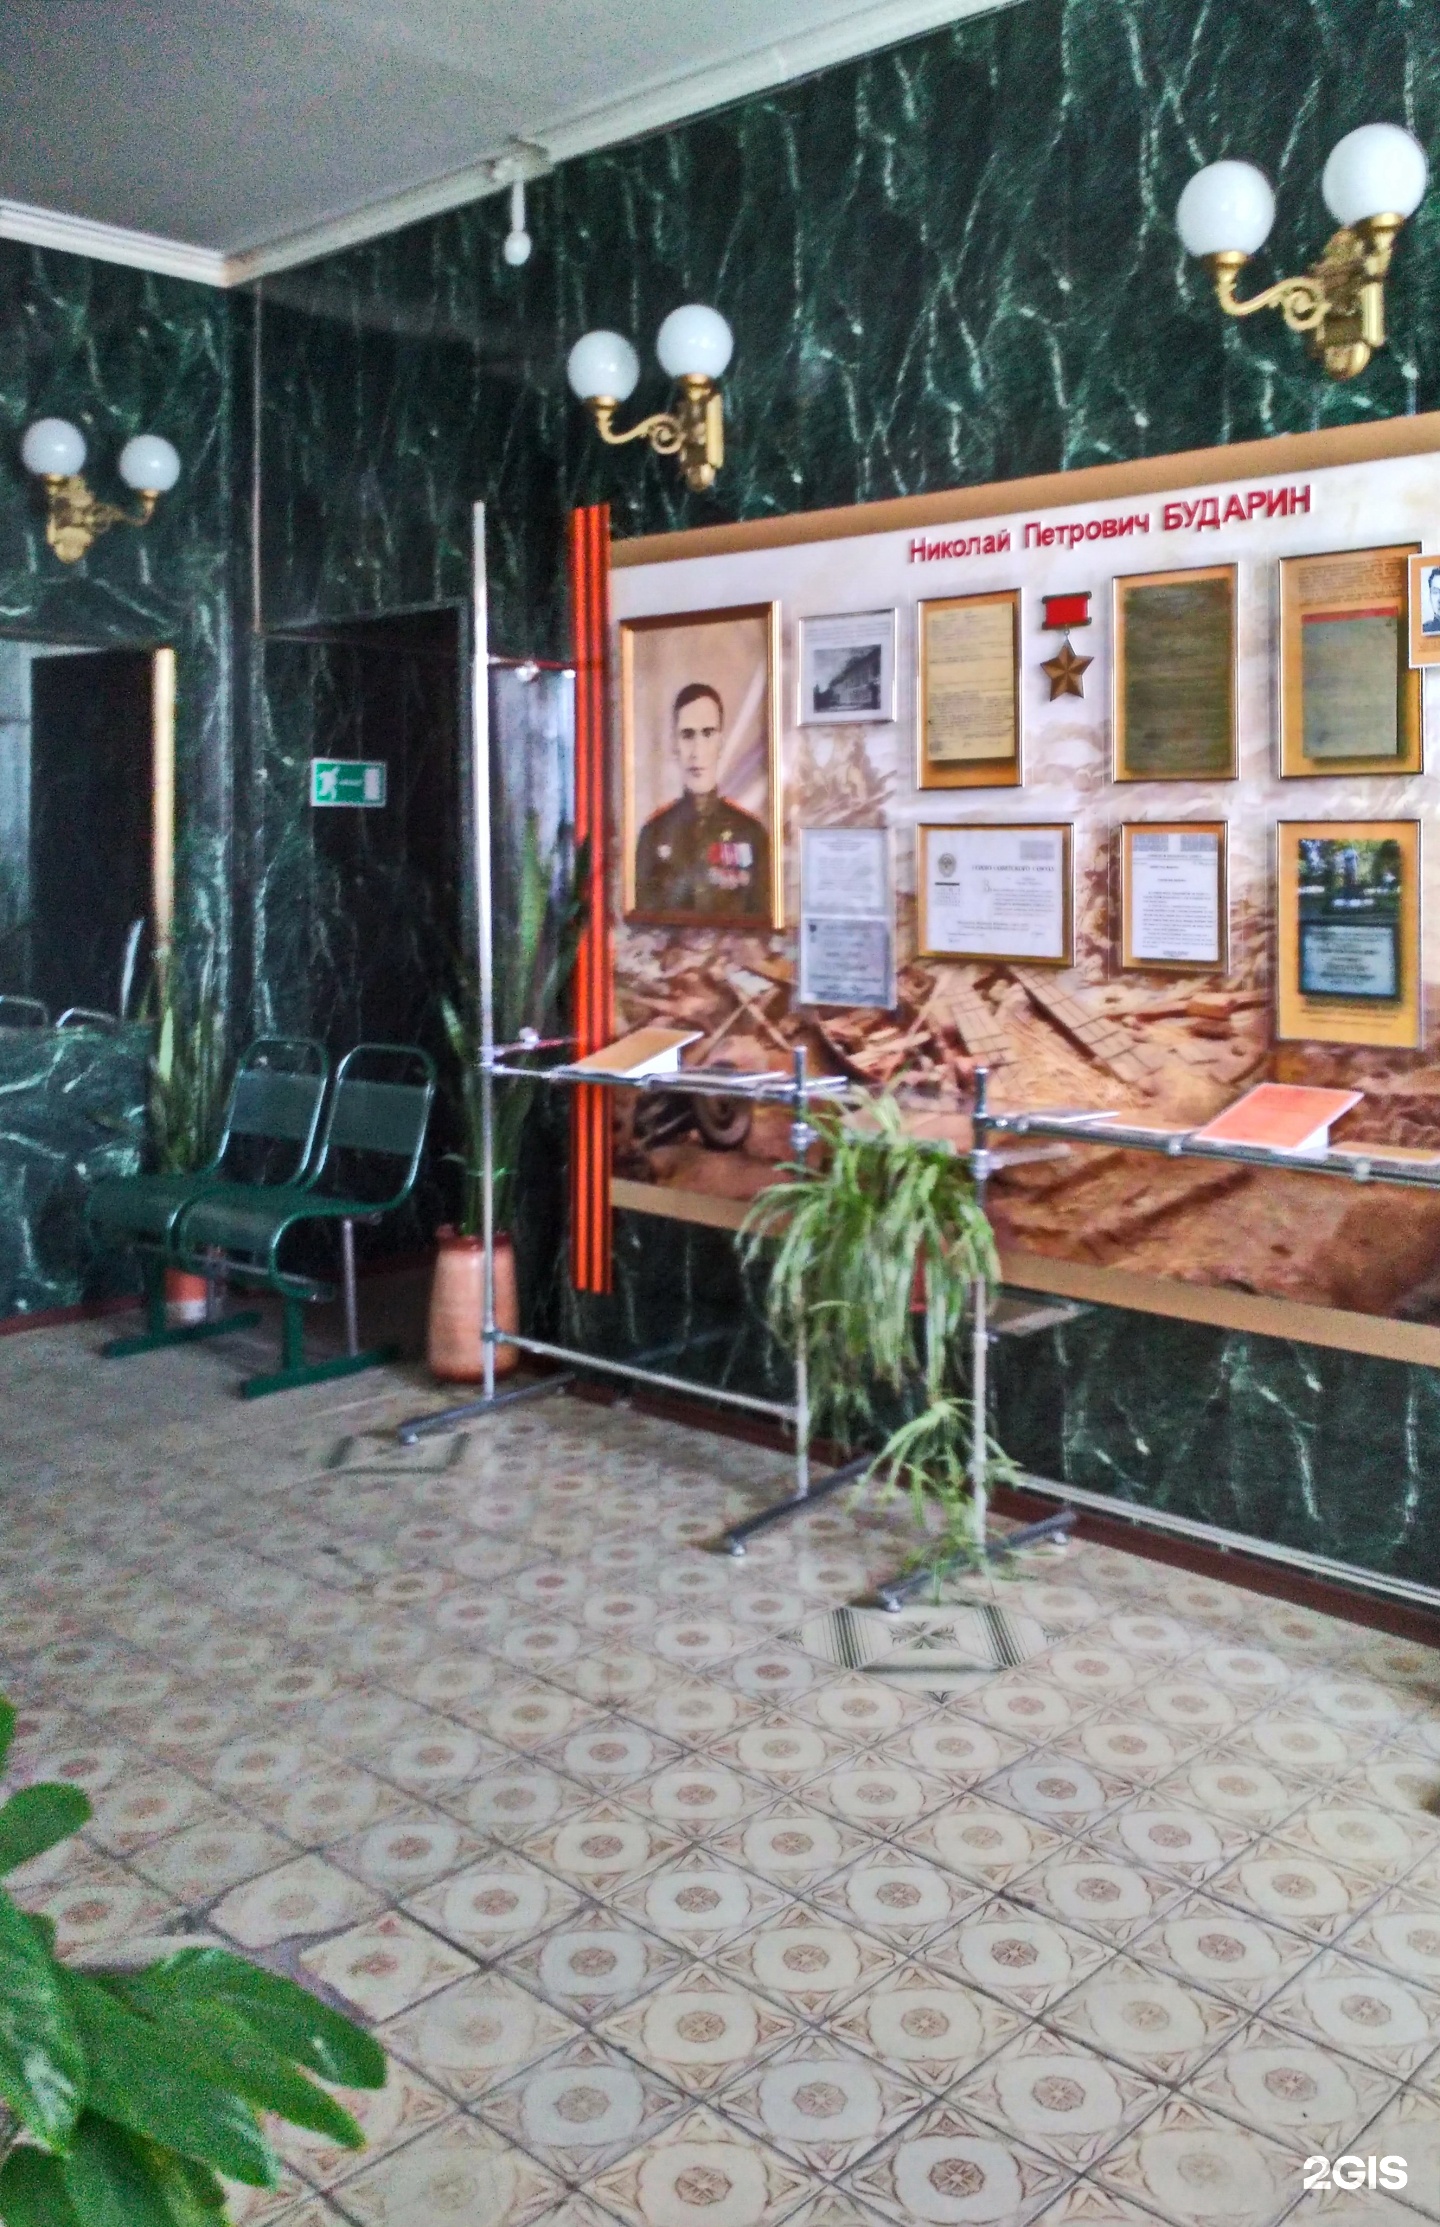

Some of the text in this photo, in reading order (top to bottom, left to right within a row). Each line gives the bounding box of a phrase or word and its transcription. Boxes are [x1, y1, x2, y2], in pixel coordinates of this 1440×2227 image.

[909, 485, 1311, 563] Николай Петрович БУДАРИН
